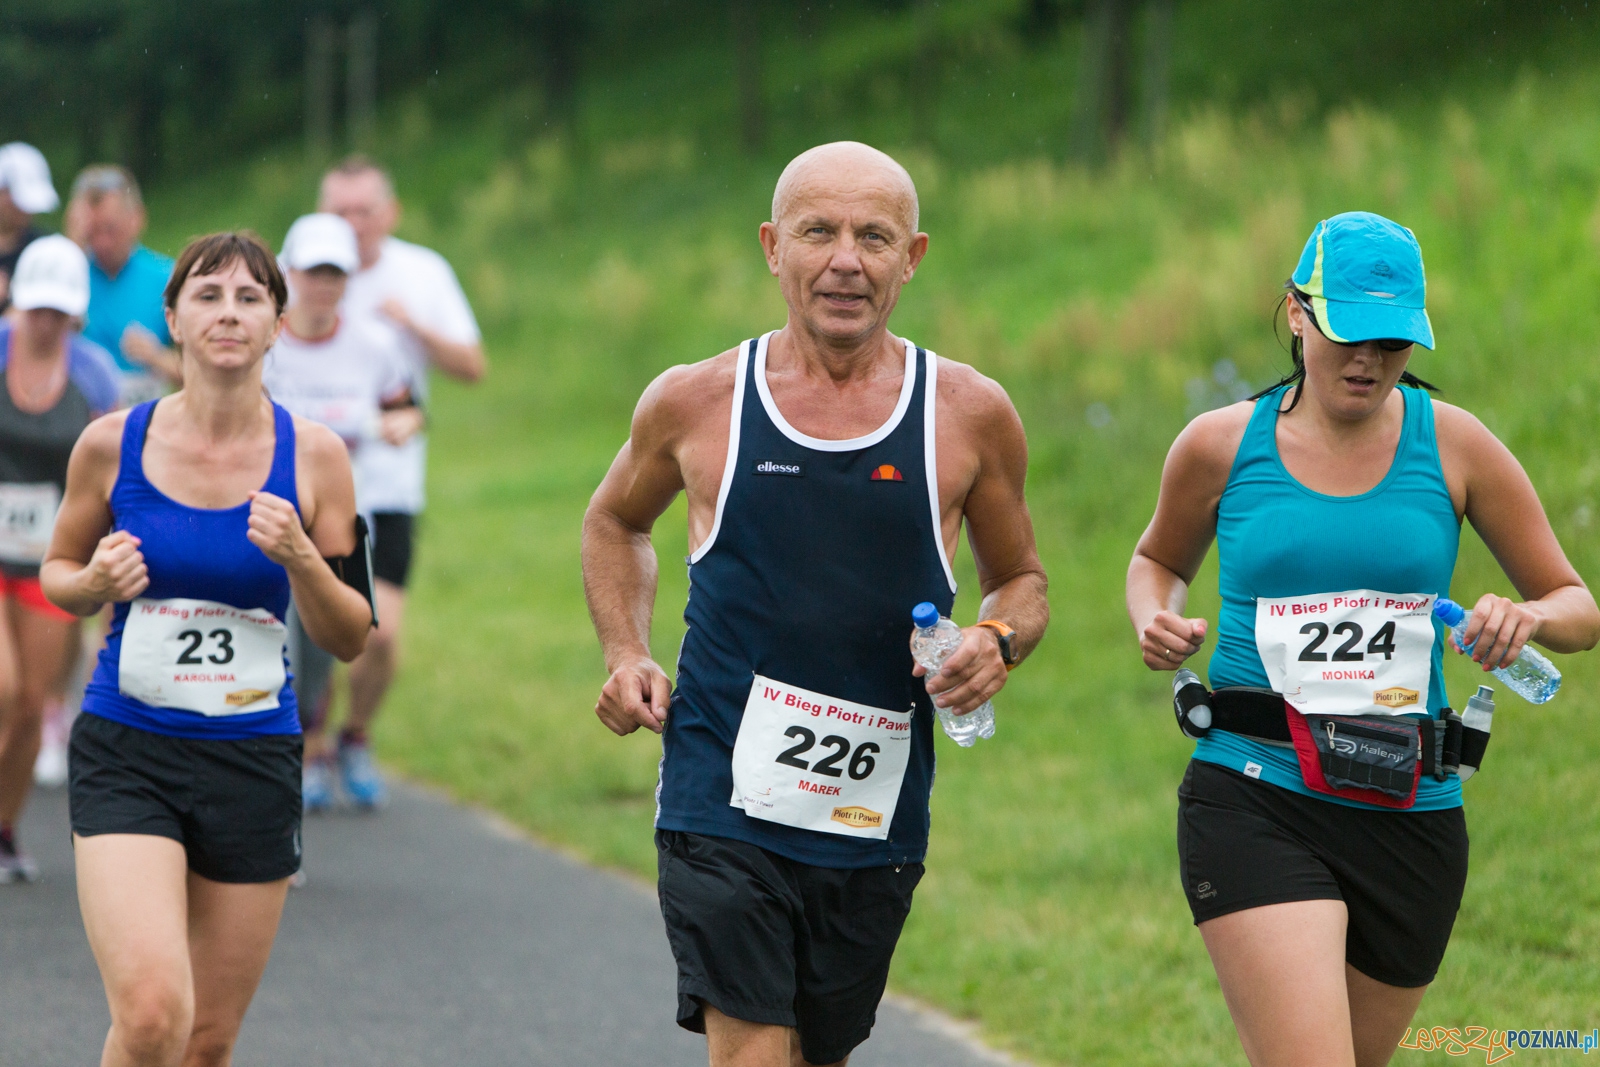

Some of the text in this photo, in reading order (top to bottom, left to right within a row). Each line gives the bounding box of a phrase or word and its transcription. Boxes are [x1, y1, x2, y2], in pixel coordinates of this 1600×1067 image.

[757, 461, 800, 474] ellesse
[140, 604, 156, 615] IV
[1270, 604, 1286, 617] IV
[1291, 601, 1328, 616] Bieg
[1333, 597, 1370, 609] Piotr
[1374, 597, 1380, 607] i
[176, 628, 235, 665] 23
[1297, 621, 1396, 662] 224
[1322, 669, 1375, 681] MONIKA
[1375, 692, 1393, 701] Piotr
[763, 686, 910, 731] IV Bieg Piotr i Pawe
[775, 725, 880, 781] 226
[1360, 743, 1404, 763] Kalenji
[798, 779, 843, 797] MAREK
[833, 809, 853, 819] Piotr
[853, 811, 857, 820] i
